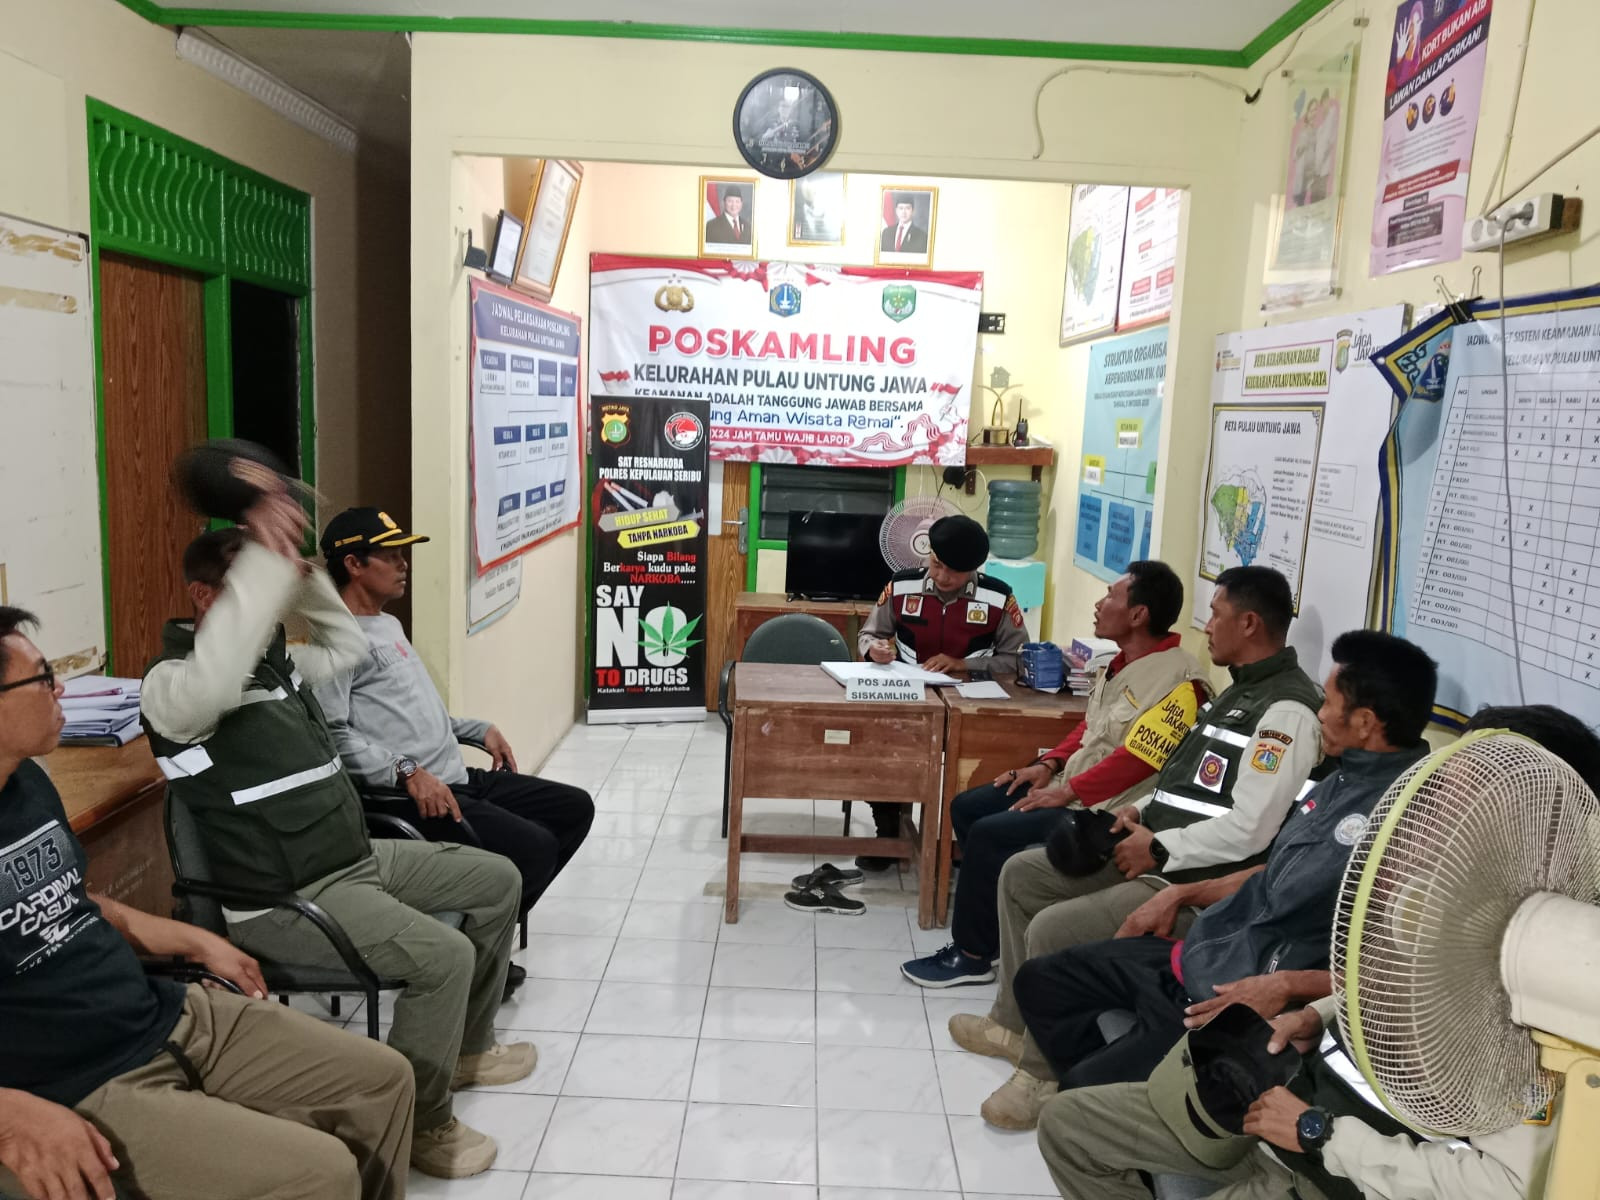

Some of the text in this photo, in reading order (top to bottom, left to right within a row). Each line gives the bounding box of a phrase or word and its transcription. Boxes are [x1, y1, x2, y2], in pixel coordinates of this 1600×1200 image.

[1390, 24, 1482, 111] LAWAN DAN LAPORKAN!
[491, 301, 514, 320] JADWAL
[1351, 333, 1372, 349] JAGA
[1514, 329, 1541, 342] SISTEM
[1541, 325, 1592, 340] KEAMANAN
[649, 325, 916, 364] POSKAMLING
[1104, 348, 1133, 368] STRUKTUR
[1550, 351, 1581, 365] PULAU
[634, 363, 927, 394] KELURAHAN PULAU UNTUNG JAWA
[1105, 368, 1144, 385] KEPENGURUSAN
[707, 393, 754, 406] ADALAH
[757, 394, 822, 409] TANGGUNG
[825, 397, 866, 411] JAWAB
[869, 399, 923, 412] BERSAMA
[738, 409, 780, 424] Aman
[786, 411, 842, 427] Wisata
[710, 428, 850, 445] X24 JAM TAMU WAJIB LAPOR
[1224, 420, 1301, 435] PETA PULAU UNTUNG JAWA
[618, 456, 684, 469] SAT RESNARKOBA
[599, 467, 702, 482] POLRES KEPULAUAN SERIBU
[614, 508, 668, 527] HIDUP SEHAT
[628, 525, 689, 543] TANPA NARKOBA
[637, 551, 697, 563] Siapa Bilang
[603, 562, 697, 576] Berkarya kudu pake
[596, 584, 645, 607] SAY
[596, 606, 688, 667] NO
[595, 667, 688, 686] TO DRUGS
[857, 678, 911, 688] POS JAGA
[851, 691, 919, 700] SISKAMLING
[1162, 700, 1184, 720] JAGA
[3, 837, 63, 892] 1973
